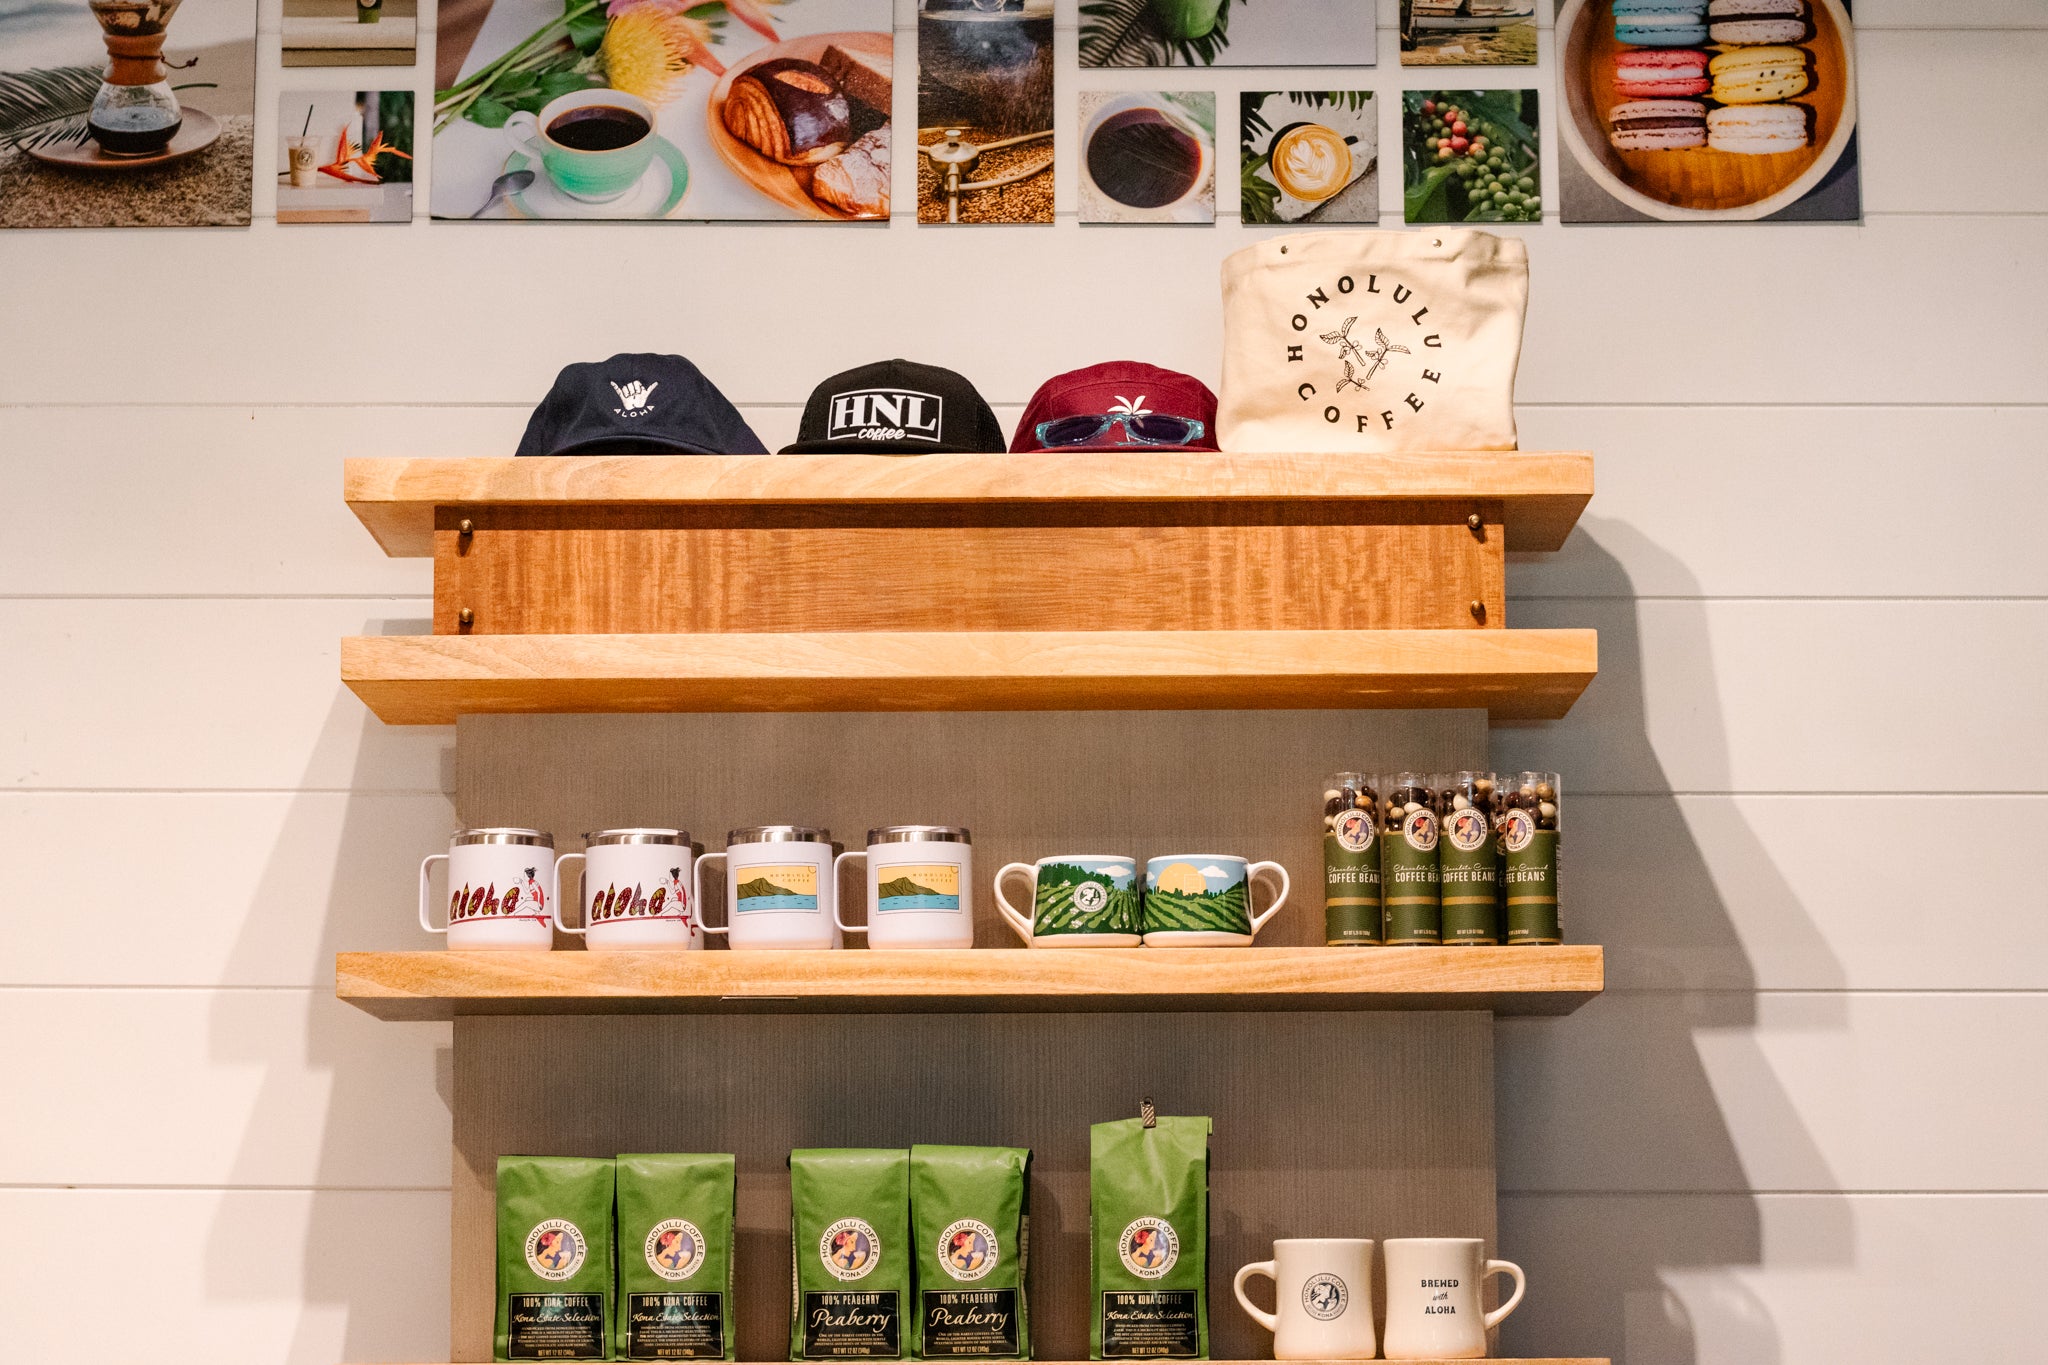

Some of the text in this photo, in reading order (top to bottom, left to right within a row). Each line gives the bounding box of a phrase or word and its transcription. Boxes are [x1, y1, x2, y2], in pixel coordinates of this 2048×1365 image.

[1288, 274, 1442, 362] HONOLULU
[1298, 368, 1441, 433] COFFEE
[832, 394, 937, 431] HNL
[858, 427, 906, 440] coffee
[1329, 873, 1356, 883] COFFEE
[1395, 872, 1425, 882] COFFEE
[1443, 872, 1468, 883] COFFEE
[1517, 872, 1545, 882] BEANS
[527, 1221, 584, 1258] HONOLULU COFFEE
[646, 1221, 703, 1258] HONOLULU COFFEE
[821, 1221, 878, 1258] HONOLULU COFFEE
[940, 1222, 996, 1259] HONOLULU COFFEE
[1121, 1219, 1178, 1256] HONOLULU COFFEE
[1421, 1279, 1459, 1288] BREWED
[523, 1296, 589, 1307] 100% KONA COFFEE
[642, 1296, 707, 1307] 100% KONA COFFEE
[821, 1294, 880, 1305] 100% PEABERRY
[940, 1293, 998, 1305] 100% PEABERRY
[1117, 1294, 1182, 1305] 100% KONA COFFEE
[1433, 1291, 1448, 1301] with
[1105, 1310, 1193, 1320] Kona Estate Selection
[1425, 1305, 1456, 1314] ALOHA
[512, 1312, 600, 1323] Kona Estate Selection
[631, 1313, 655, 1323] Kona
[680, 1312, 719, 1321] Selection
[810, 1307, 891, 1333] Peaberry
[929, 1306, 1009, 1332] Peaberry
